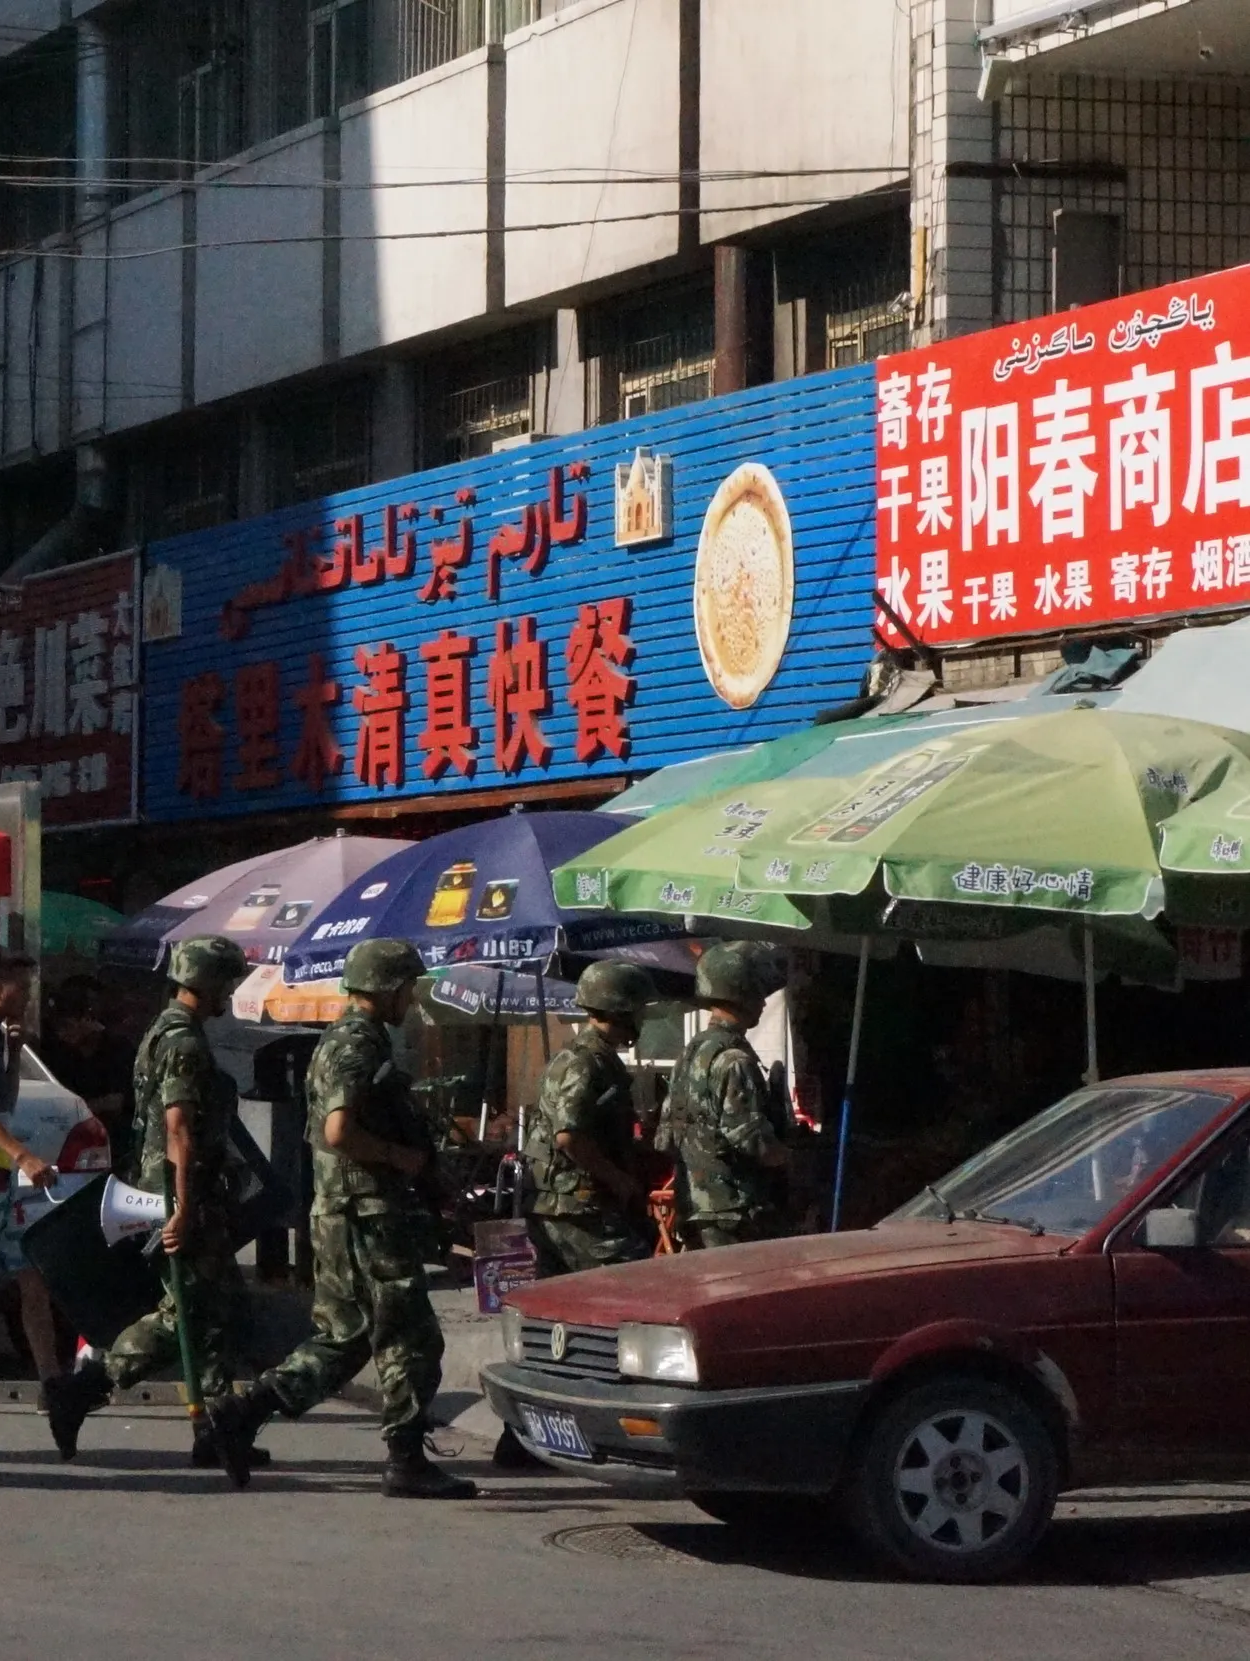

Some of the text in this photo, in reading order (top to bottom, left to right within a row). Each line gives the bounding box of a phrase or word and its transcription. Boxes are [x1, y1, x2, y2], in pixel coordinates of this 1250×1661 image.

[878, 362, 952, 450] 寄存
[961, 341, 1250, 551] 阳春商店
[878, 456, 952, 542] 干果
[877, 549, 953, 634] 水果
[962, 535, 1250, 625] 干果 水果 寄存 烟酒
[954, 863, 1093, 901] 健康好心情
[582, 923, 683, 943] www.recca.co
